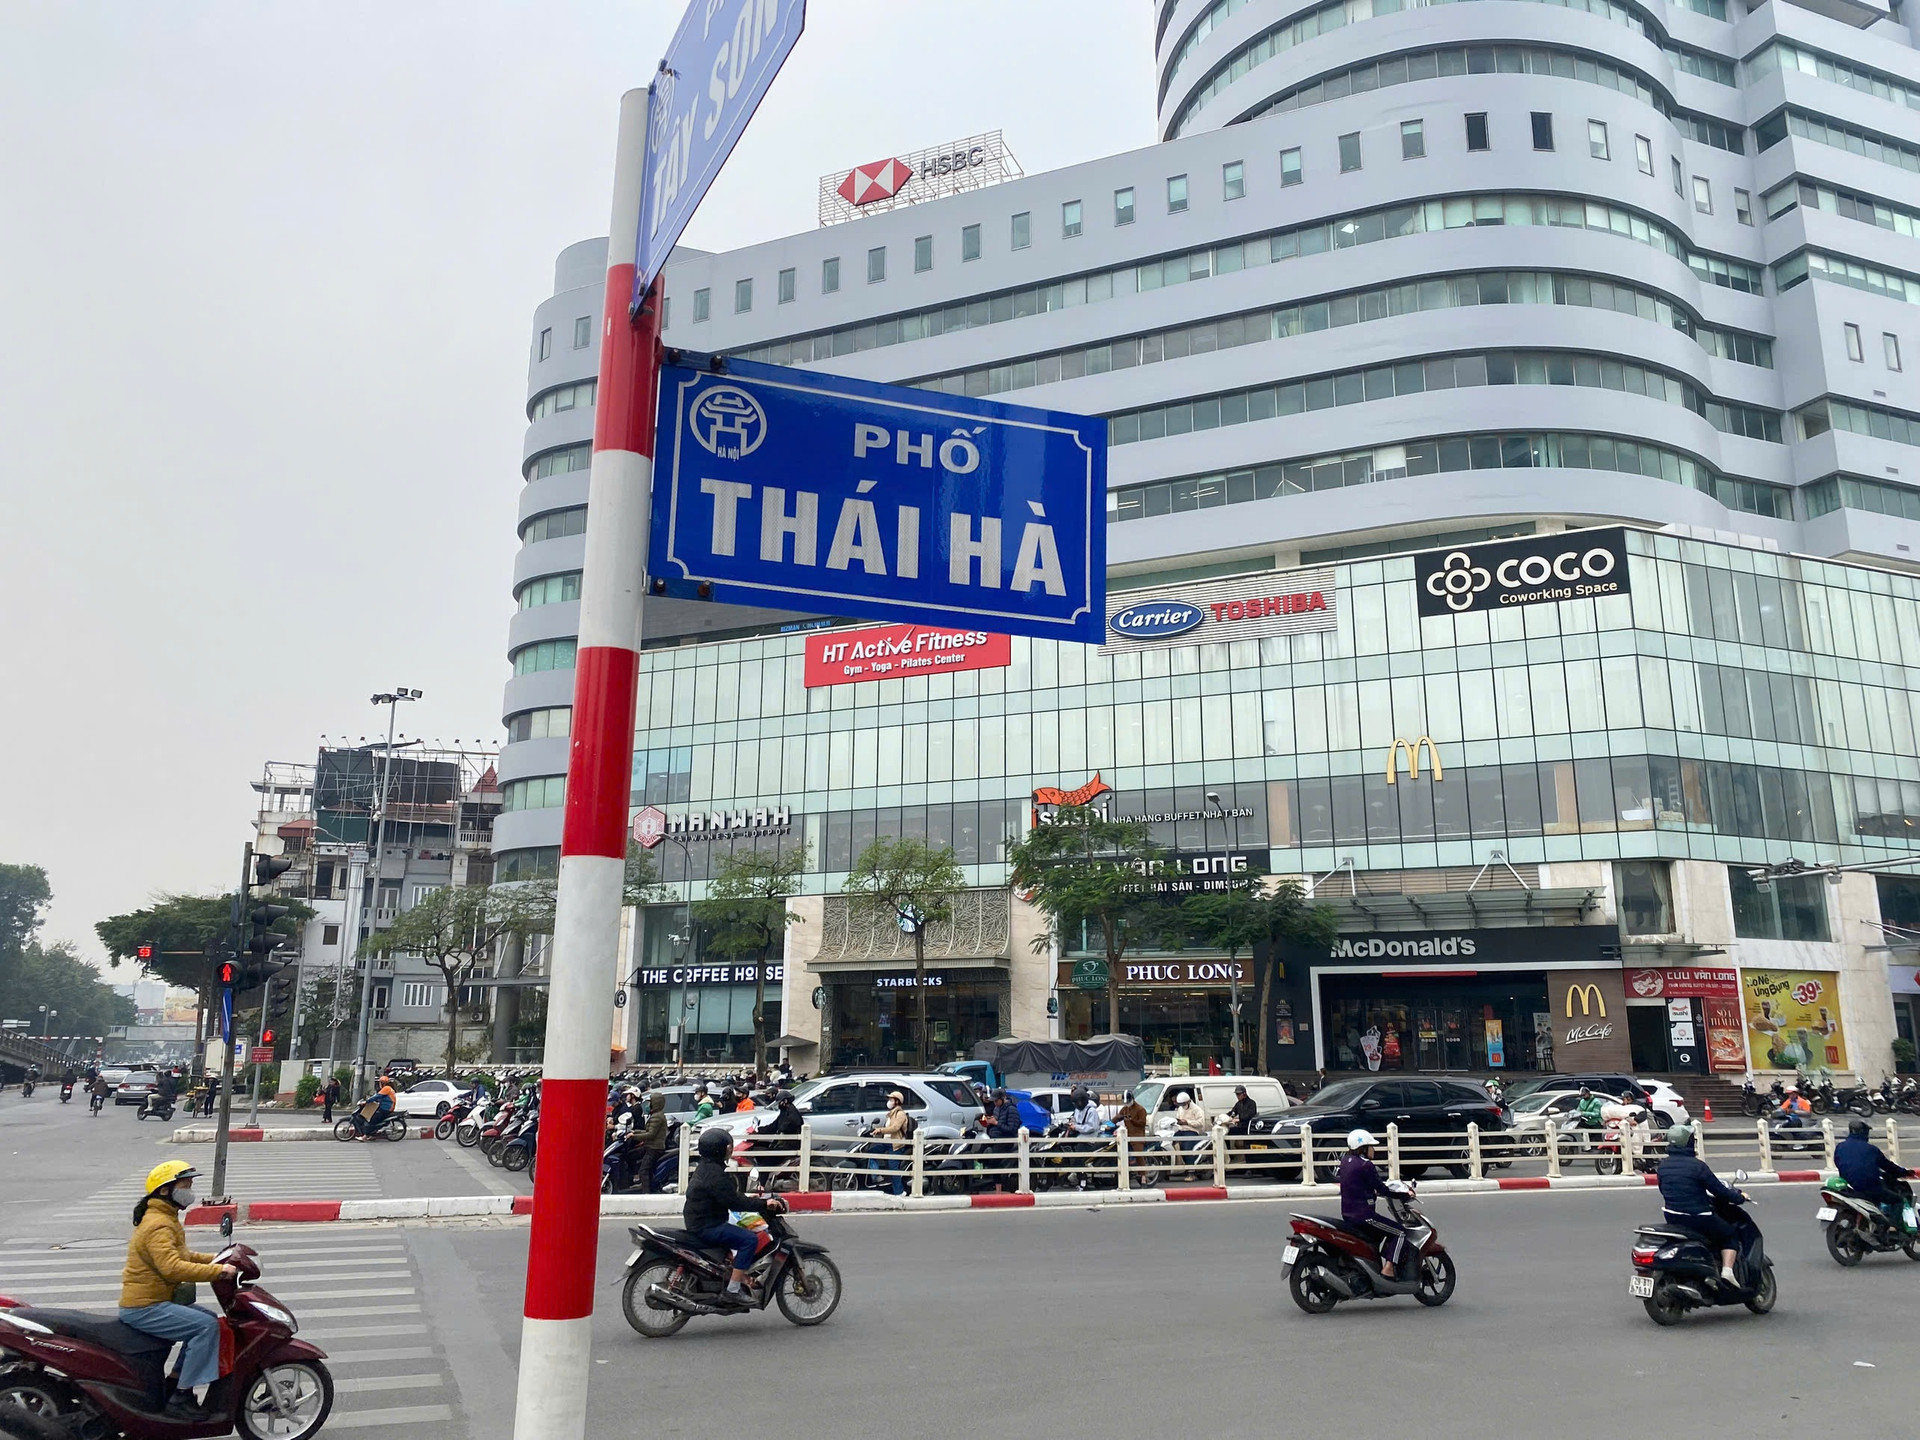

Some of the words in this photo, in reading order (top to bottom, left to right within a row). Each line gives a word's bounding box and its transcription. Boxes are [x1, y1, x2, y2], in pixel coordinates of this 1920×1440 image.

[920, 146, 983, 180] HSBC
[853, 422, 987, 475] PHỐ
[700, 477, 920, 579] THÁI
[949, 500, 1068, 598] HÀ
[1496, 548, 1615, 588] COGO
[1499, 586, 1572, 605] Coworking
[1575, 582, 1618, 596] Space
[1210, 590, 1328, 622] TOSHIBA
[1118, 608, 1193, 628] Carrier
[823, 642, 849, 663] HT
[851, 632, 914, 660] Active
[915, 631, 988, 653] Fitness
[844, 664, 863, 676] Gym
[871, 661, 893, 674] Yoga
[901, 656, 932, 669] Pilates
[934, 653, 966, 665] Center
[1164, 809, 1200, 821] BUFFET
[743, 826, 791, 838] HOTPOT
[1330, 937, 1476, 958] McDonald's
[642, 969, 668, 984] THE
[734, 966, 784, 981] HOSE
[1126, 965, 1181, 980] PHUC
[1187, 963, 1244, 980] LONG
